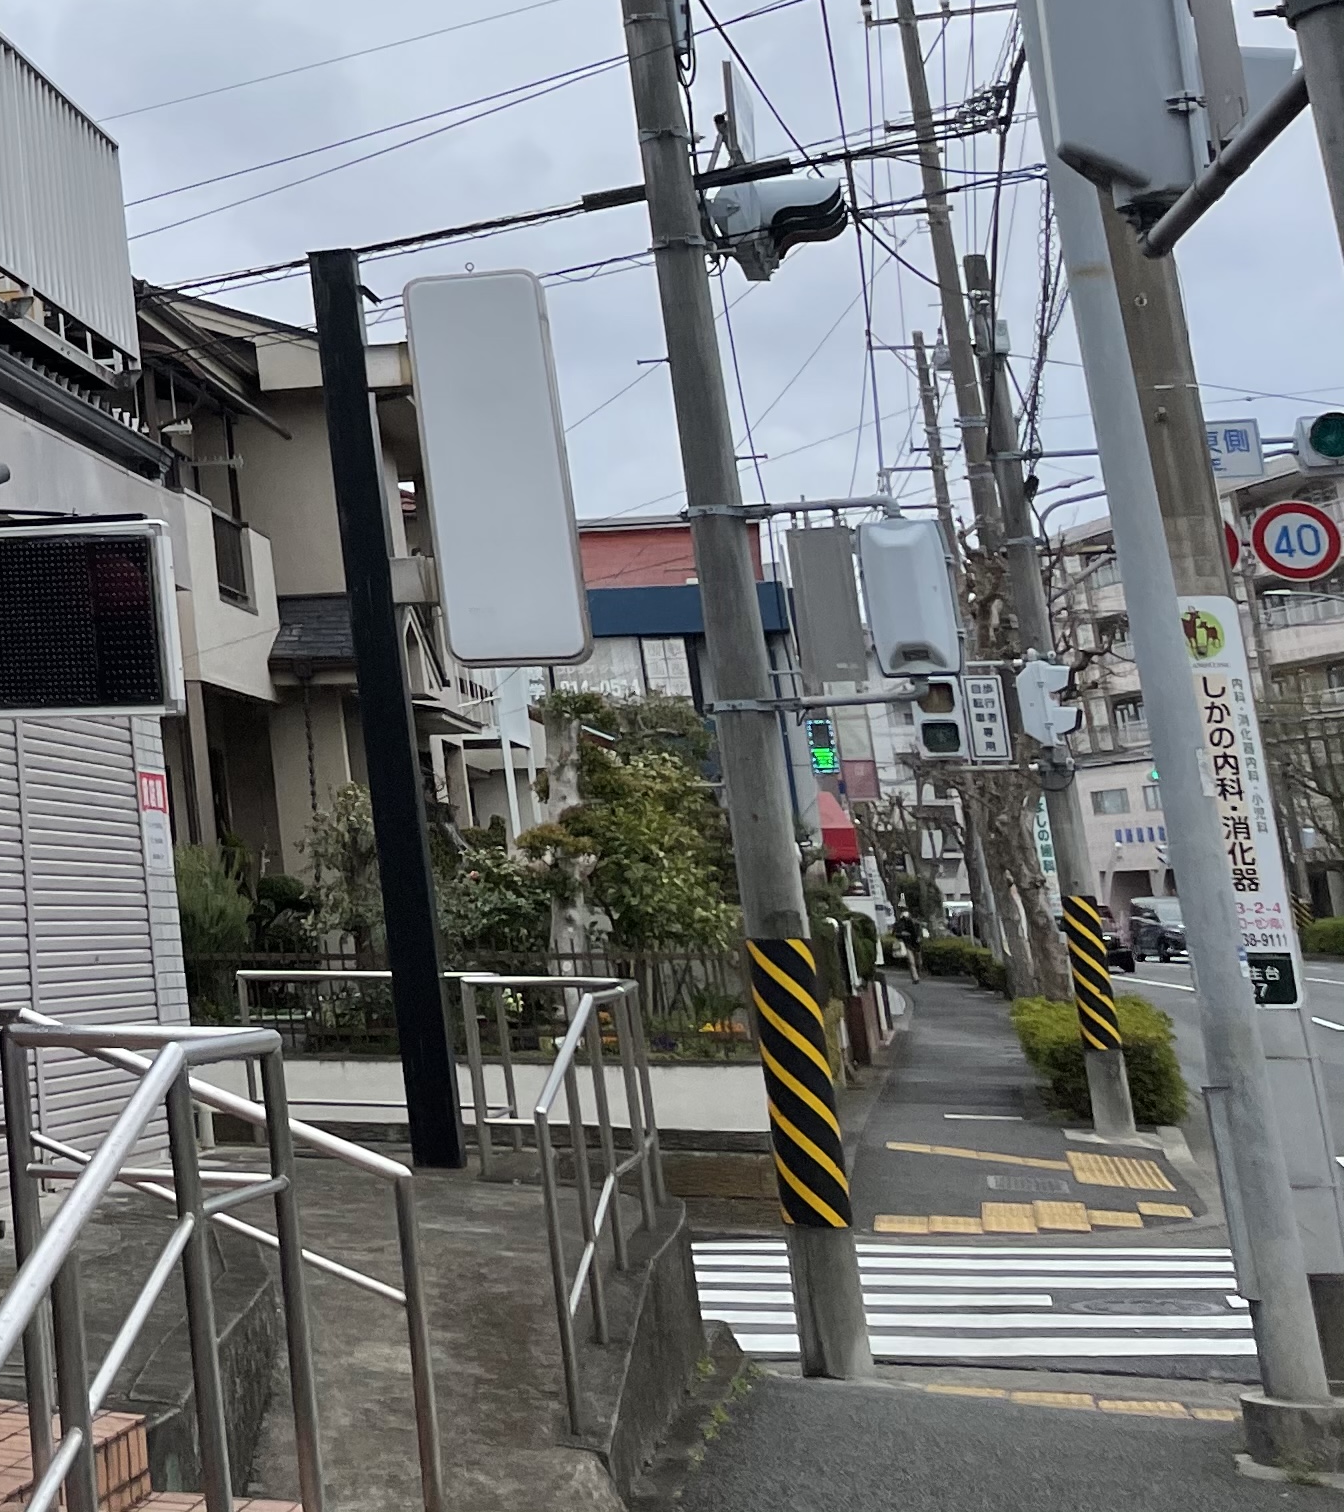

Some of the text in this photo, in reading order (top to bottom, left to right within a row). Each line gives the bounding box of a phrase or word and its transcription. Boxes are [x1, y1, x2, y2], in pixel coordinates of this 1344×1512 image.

[1274, 523, 1321, 557] 40
[1202, 675, 1260, 893] しかの内科・消化器
